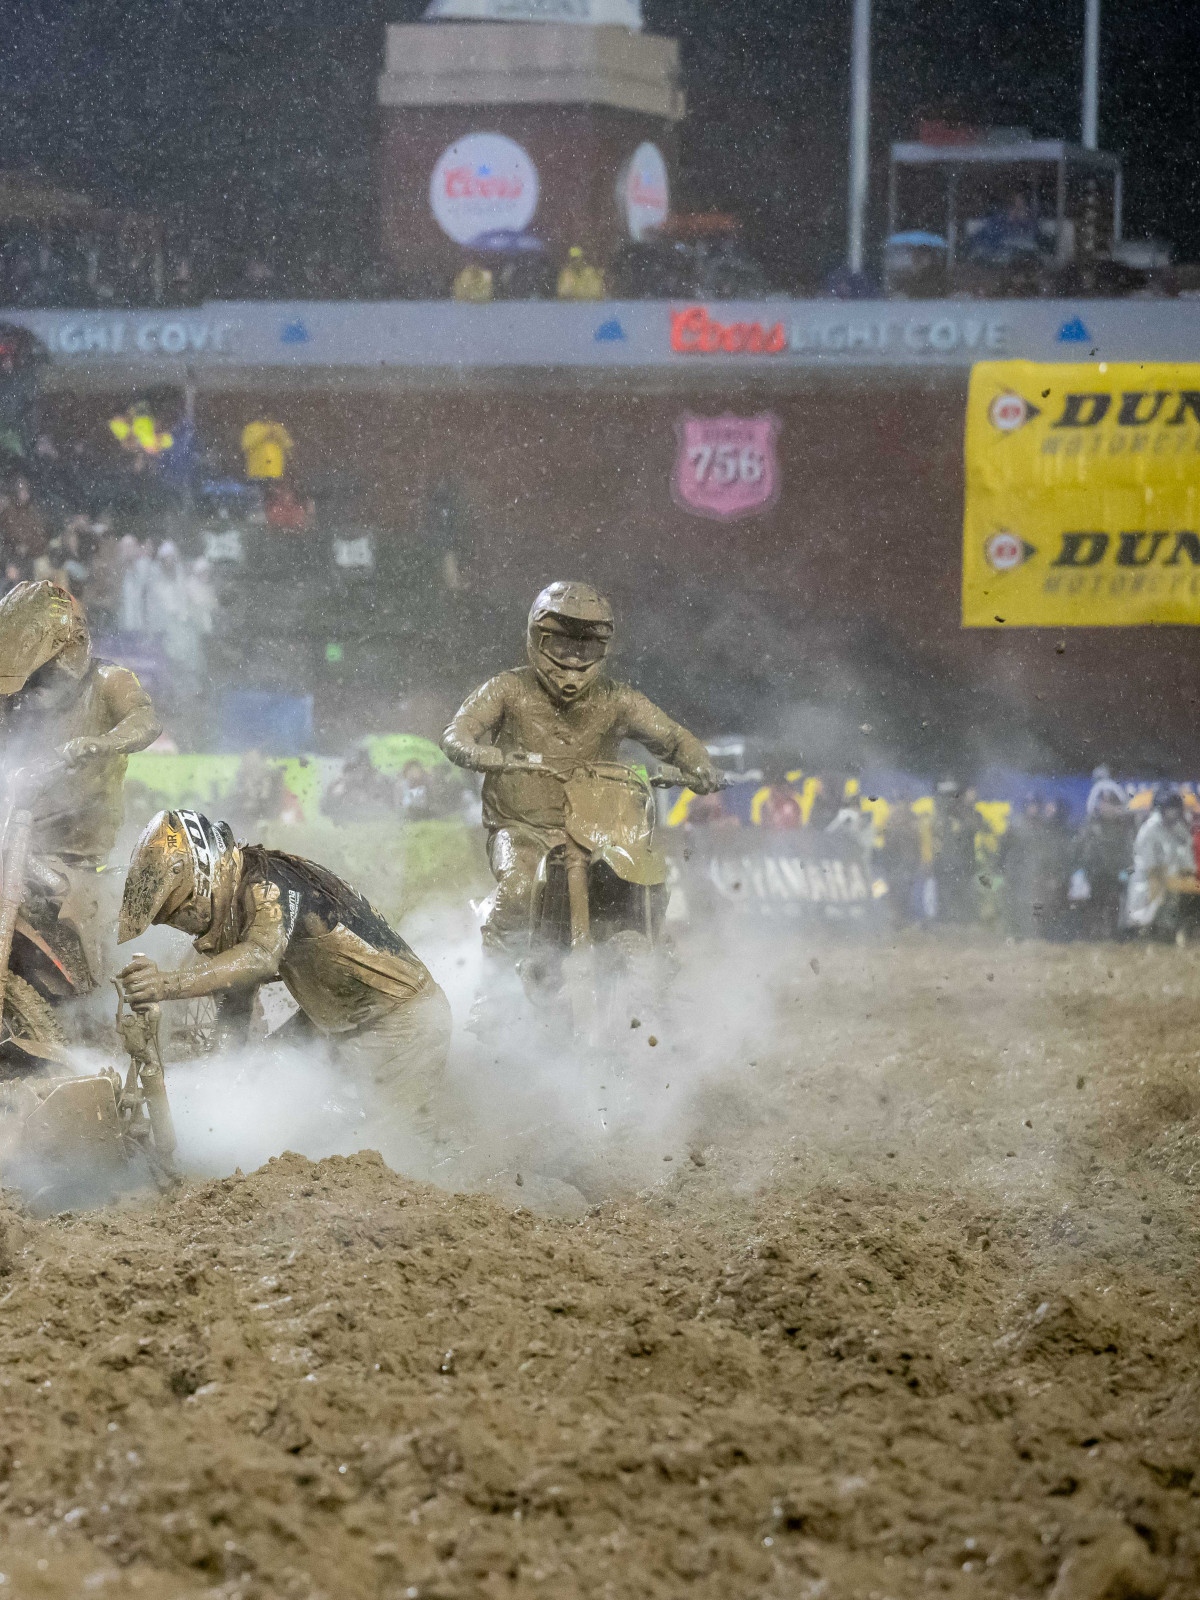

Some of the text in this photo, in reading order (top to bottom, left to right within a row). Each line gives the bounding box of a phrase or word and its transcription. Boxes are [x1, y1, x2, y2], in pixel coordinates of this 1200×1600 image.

[670, 306, 1010, 353] Coors LIGHT COVE
[687, 445, 764, 485] 756
